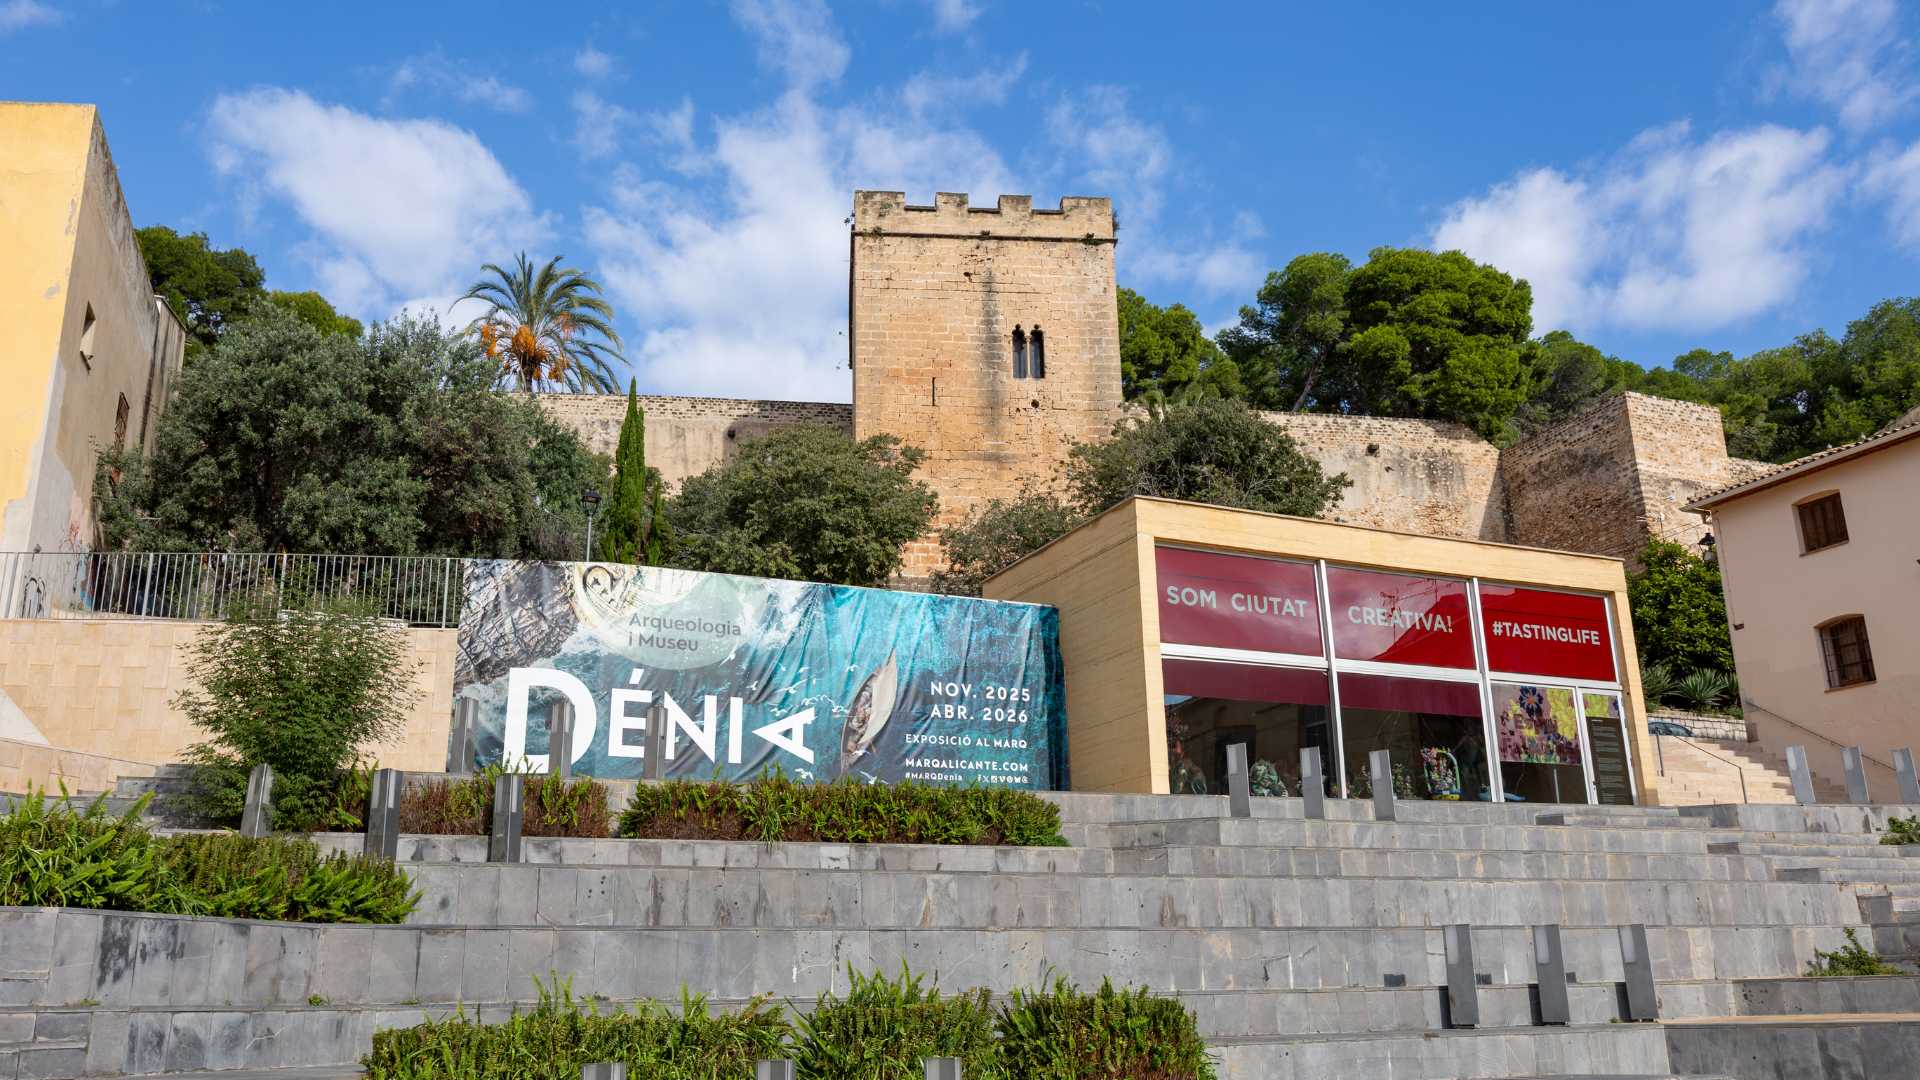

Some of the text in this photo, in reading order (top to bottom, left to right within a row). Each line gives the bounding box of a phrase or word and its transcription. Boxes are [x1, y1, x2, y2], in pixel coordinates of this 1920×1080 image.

[628, 612, 742, 638] Arqueologia
[1167, 585, 1602, 646] SOM CIUTAT CREATIVA! #TASTINGLIFE
[628, 631, 699, 651] i Museu
[930, 681, 1031, 702] NOV. 2025
[502, 667, 816, 774] DÉNIA
[930, 703, 1028, 723] ABR. 2026
[905, 733, 1028, 749] EXPOSICIÓ AL MARQ
[905, 757, 1029, 772] MARQALICANTE.COM
